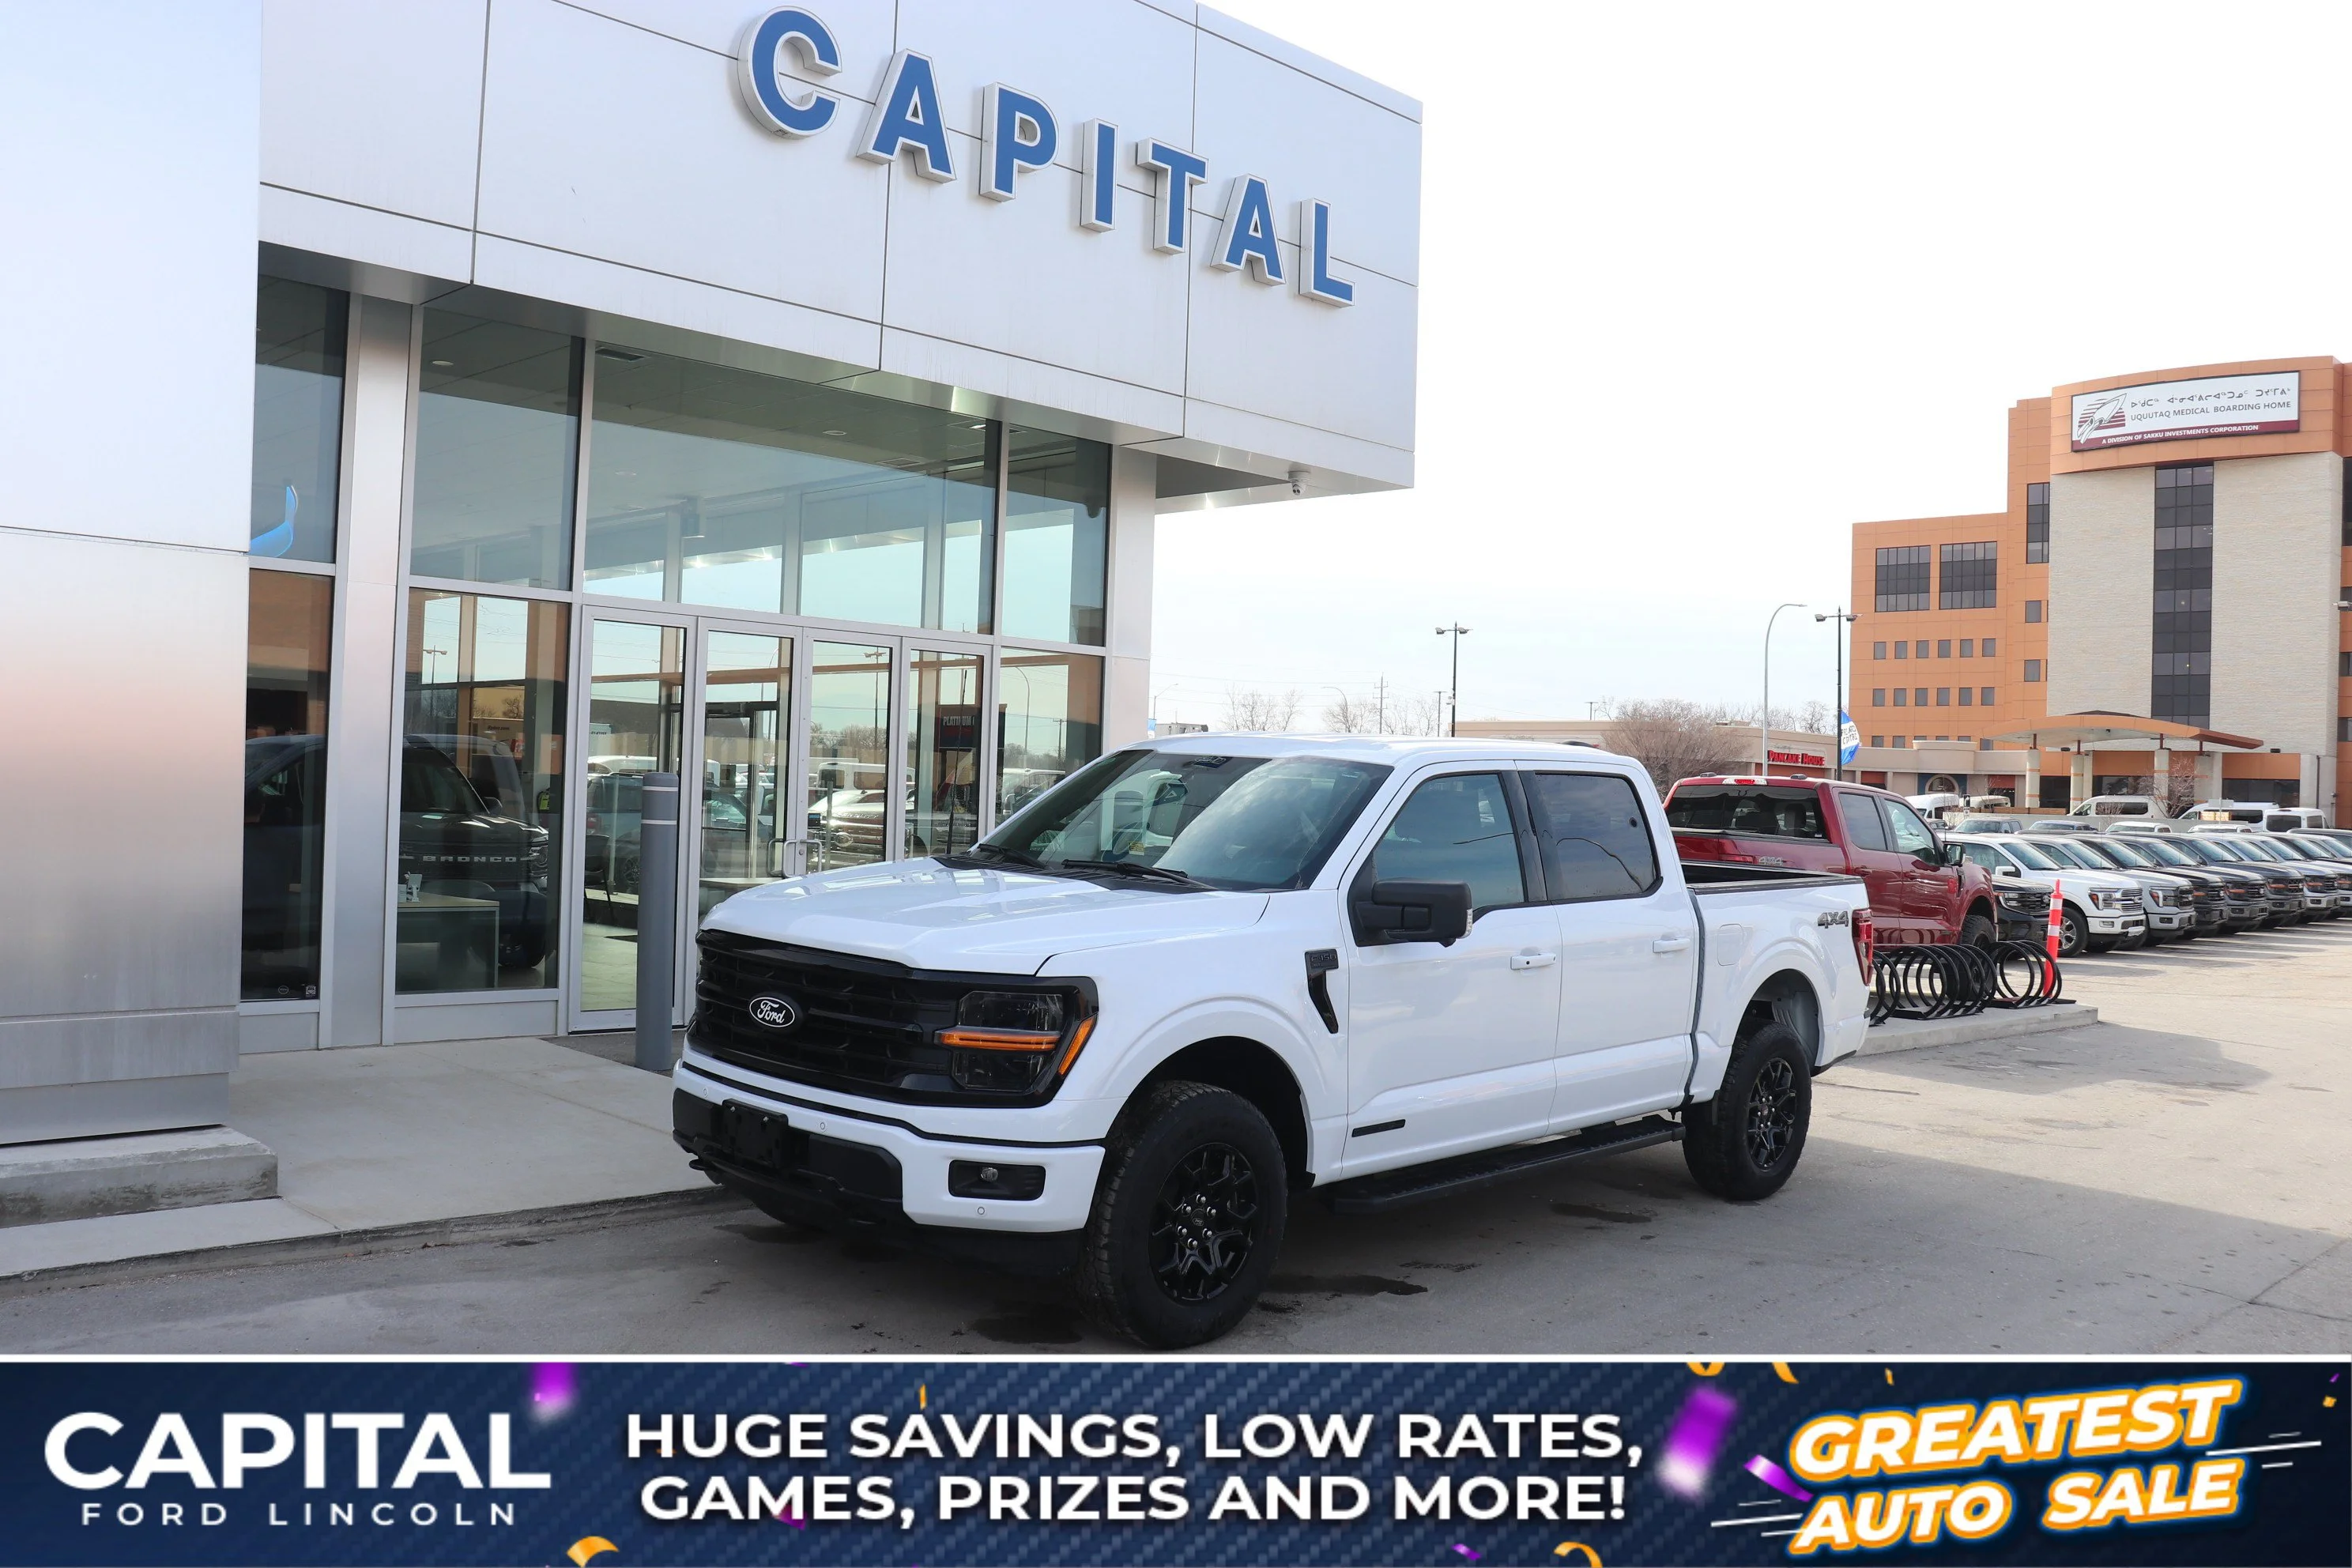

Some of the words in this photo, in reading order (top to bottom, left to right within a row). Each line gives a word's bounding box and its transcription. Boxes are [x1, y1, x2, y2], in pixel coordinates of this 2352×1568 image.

[743, 6, 1355, 305] CAPITAL
[2130, 410, 2171, 421] UQUUTAQ
[2173, 407, 2211, 416] MEDICAL
[2213, 403, 2261, 413] BOARDING
[2263, 401, 2291, 409] HOME
[2107, 435, 2133, 443] DIVISION
[2164, 428, 2209, 437] INVESTMENTS
[2210, 424, 2259, 433] CORPORATION
[1767, 750, 1801, 764] PANCAKE
[1801, 752, 1825, 766] HOUSE
[756, 1000, 786, 1023] Ford
